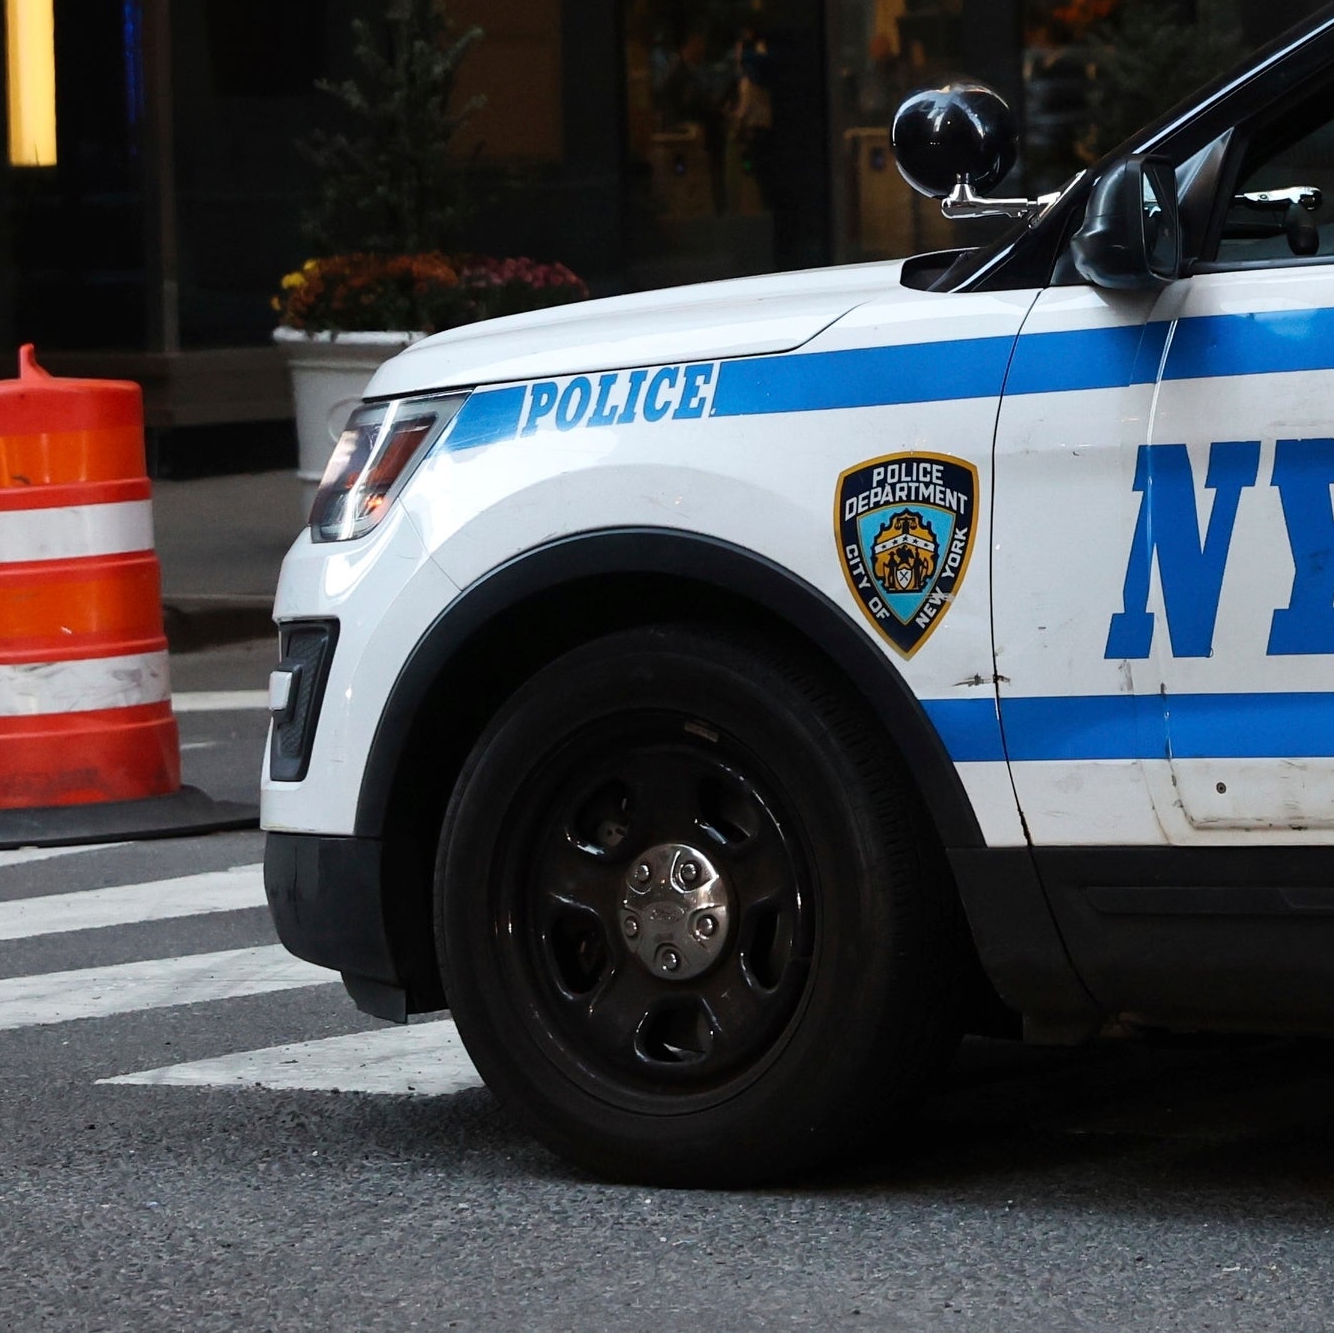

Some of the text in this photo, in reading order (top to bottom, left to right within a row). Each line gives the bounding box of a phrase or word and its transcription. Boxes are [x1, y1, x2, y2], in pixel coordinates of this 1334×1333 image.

[520, 362, 715, 438] POLICE
[844, 482, 968, 522] DEPARTMENT
[872, 462, 945, 488] POLICE
[845, 526, 969, 630] CITY OF NEW YORK
